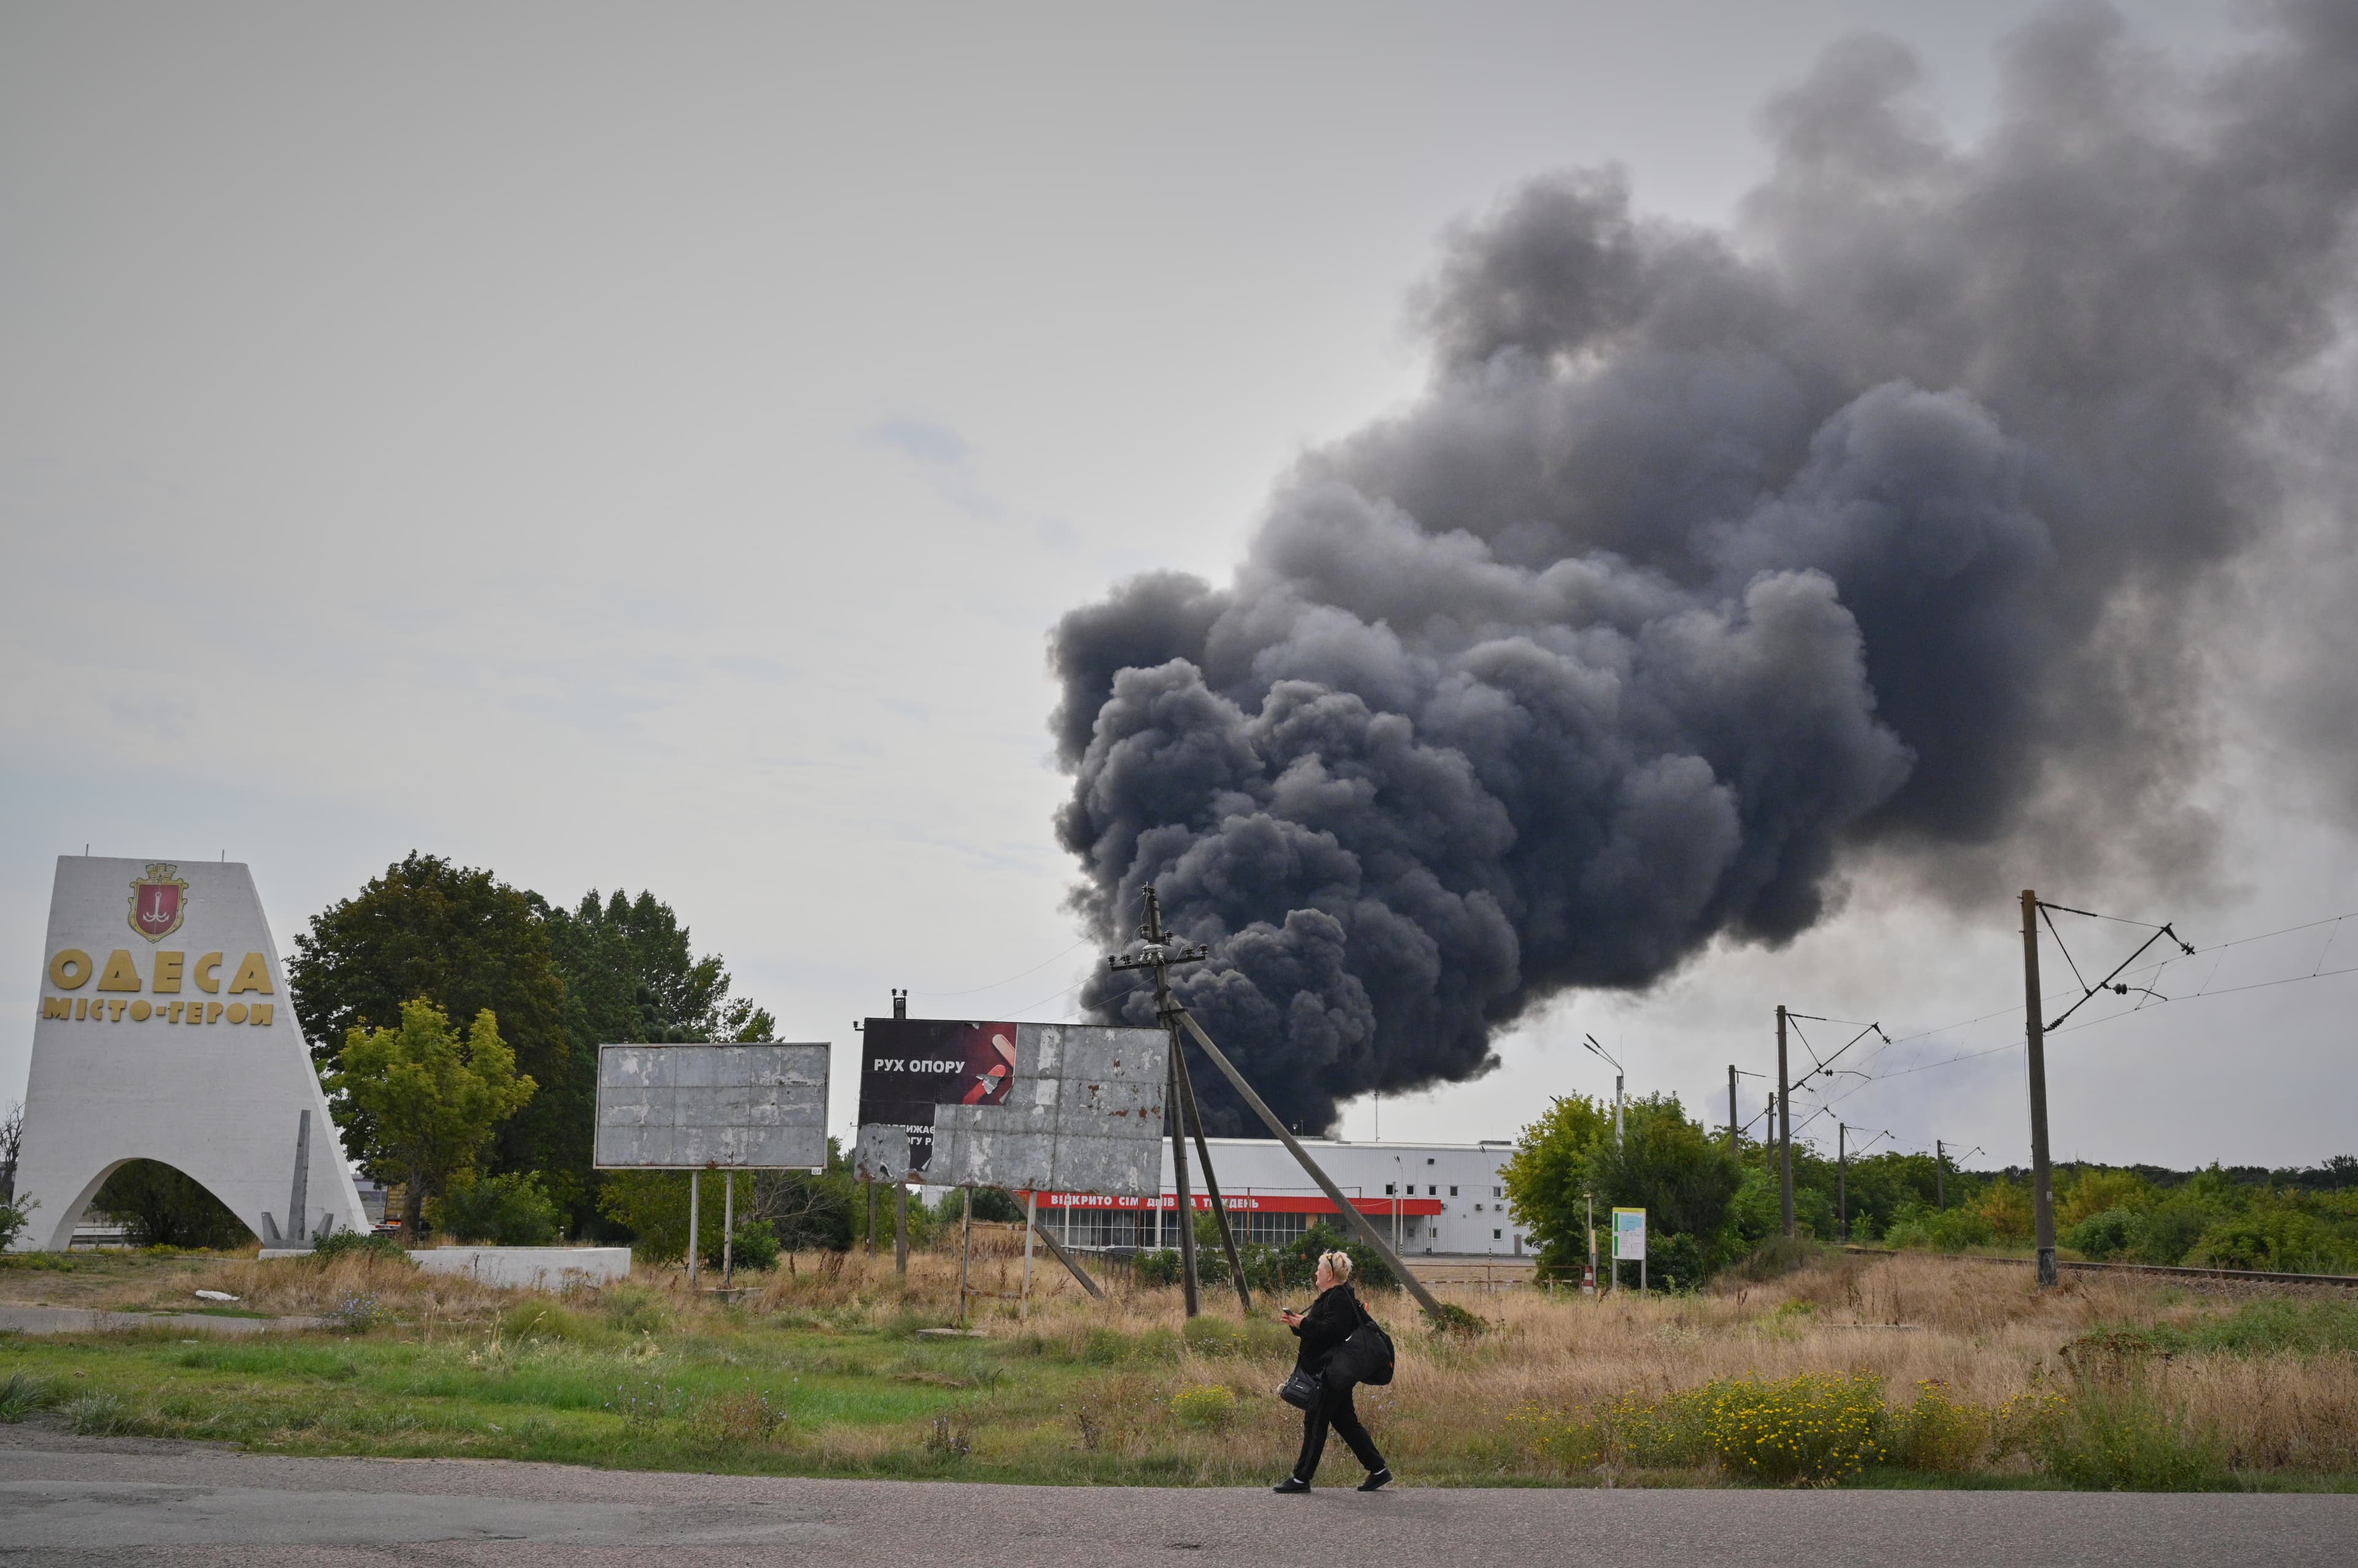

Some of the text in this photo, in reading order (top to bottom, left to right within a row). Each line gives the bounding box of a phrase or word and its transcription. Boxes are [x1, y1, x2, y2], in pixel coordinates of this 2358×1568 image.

[49, 949, 274, 995] ОДЕСА
[874, 1058, 965, 1074] РУХ ОПОРУ
[1051, 1195, 1113, 1206] ВІДКРИТО
[1118, 1197, 1138, 1206] СІМ
[1146, 1197, 1175, 1207] ДІВ
